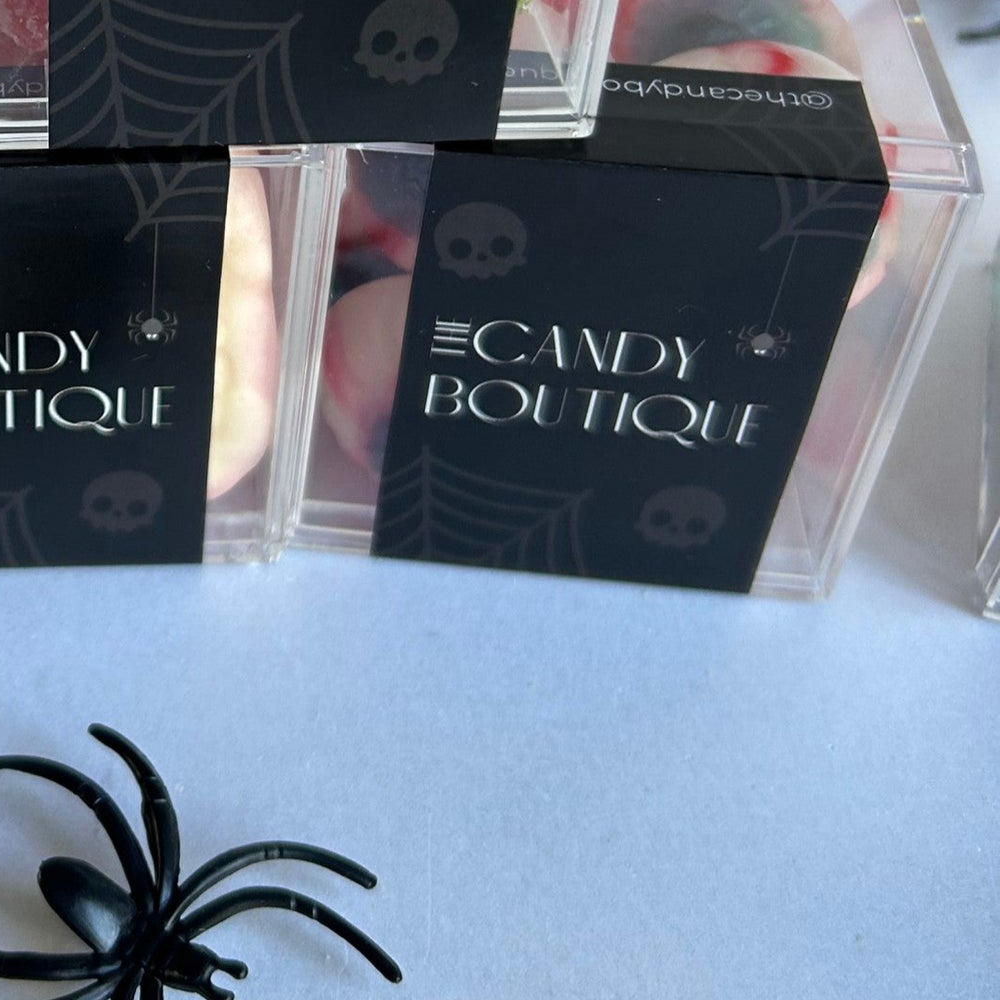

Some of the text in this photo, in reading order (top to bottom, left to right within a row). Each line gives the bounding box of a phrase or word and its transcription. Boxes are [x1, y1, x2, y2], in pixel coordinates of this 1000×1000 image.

[429, 315, 707, 382] THE CANDY
[423, 372, 770, 449] BOUTIQUE
